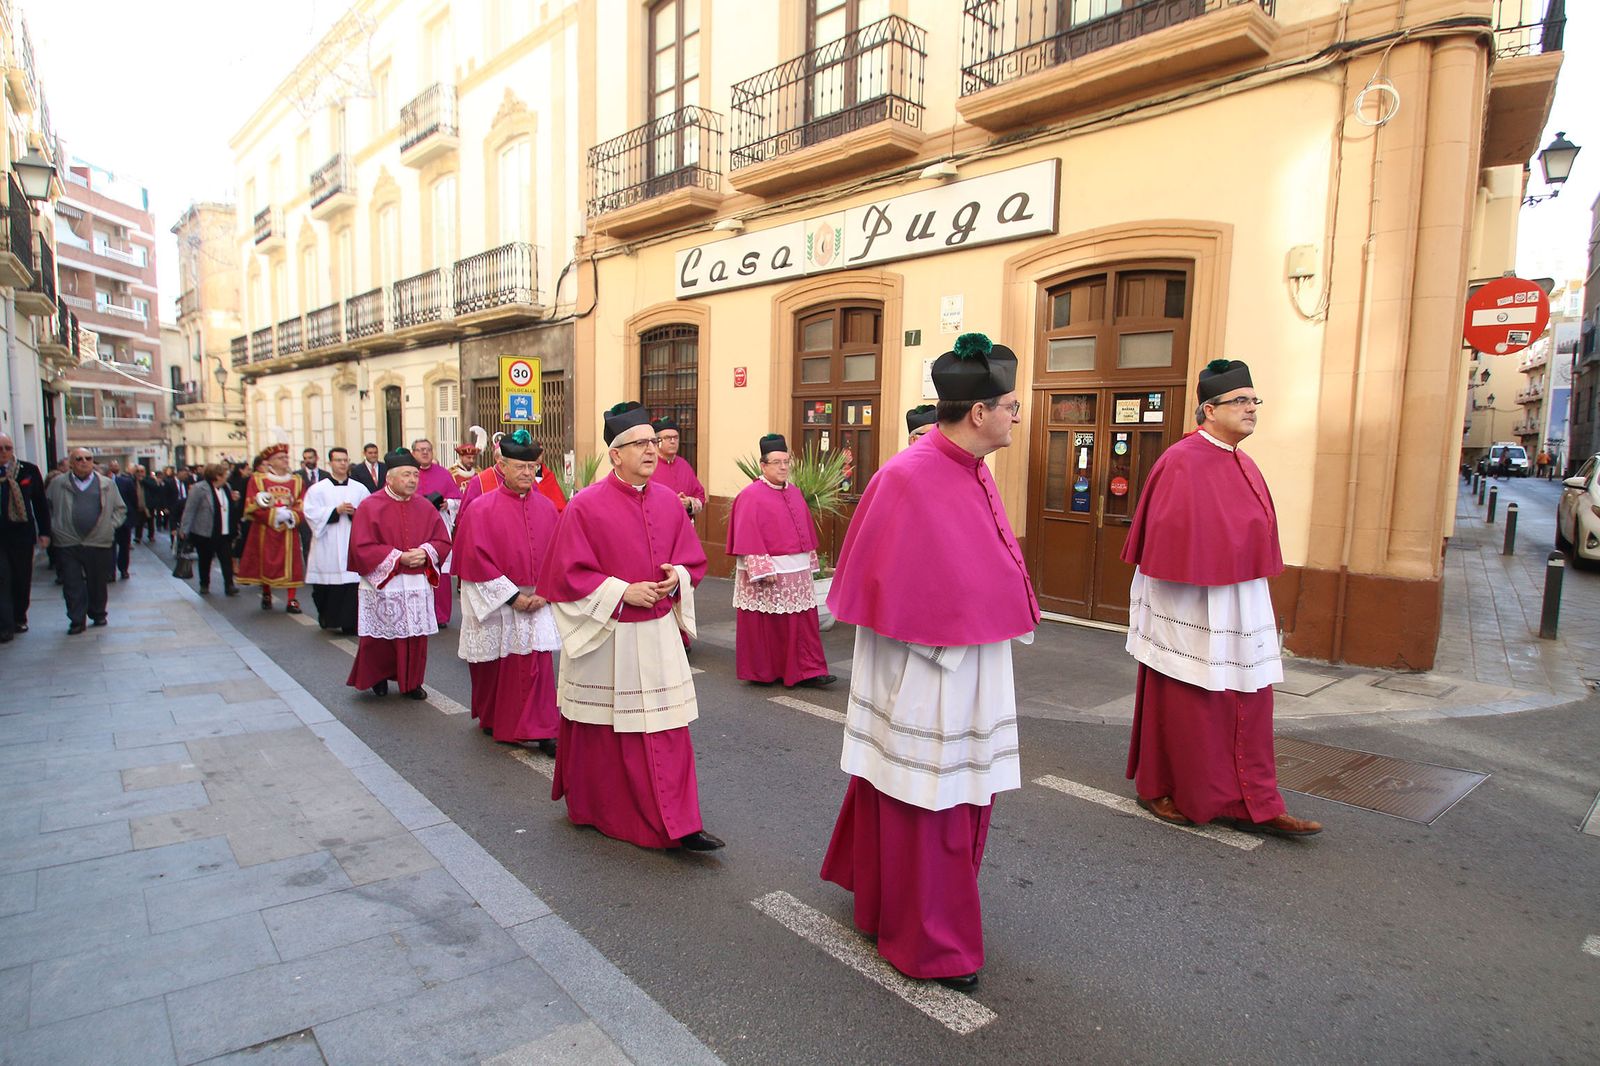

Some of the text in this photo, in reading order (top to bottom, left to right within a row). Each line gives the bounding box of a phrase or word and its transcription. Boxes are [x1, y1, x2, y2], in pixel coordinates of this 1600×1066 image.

[680, 192, 1034, 288] Casa Puga
[908, 331, 916, 345] 7
[513, 368, 528, 379] 30
